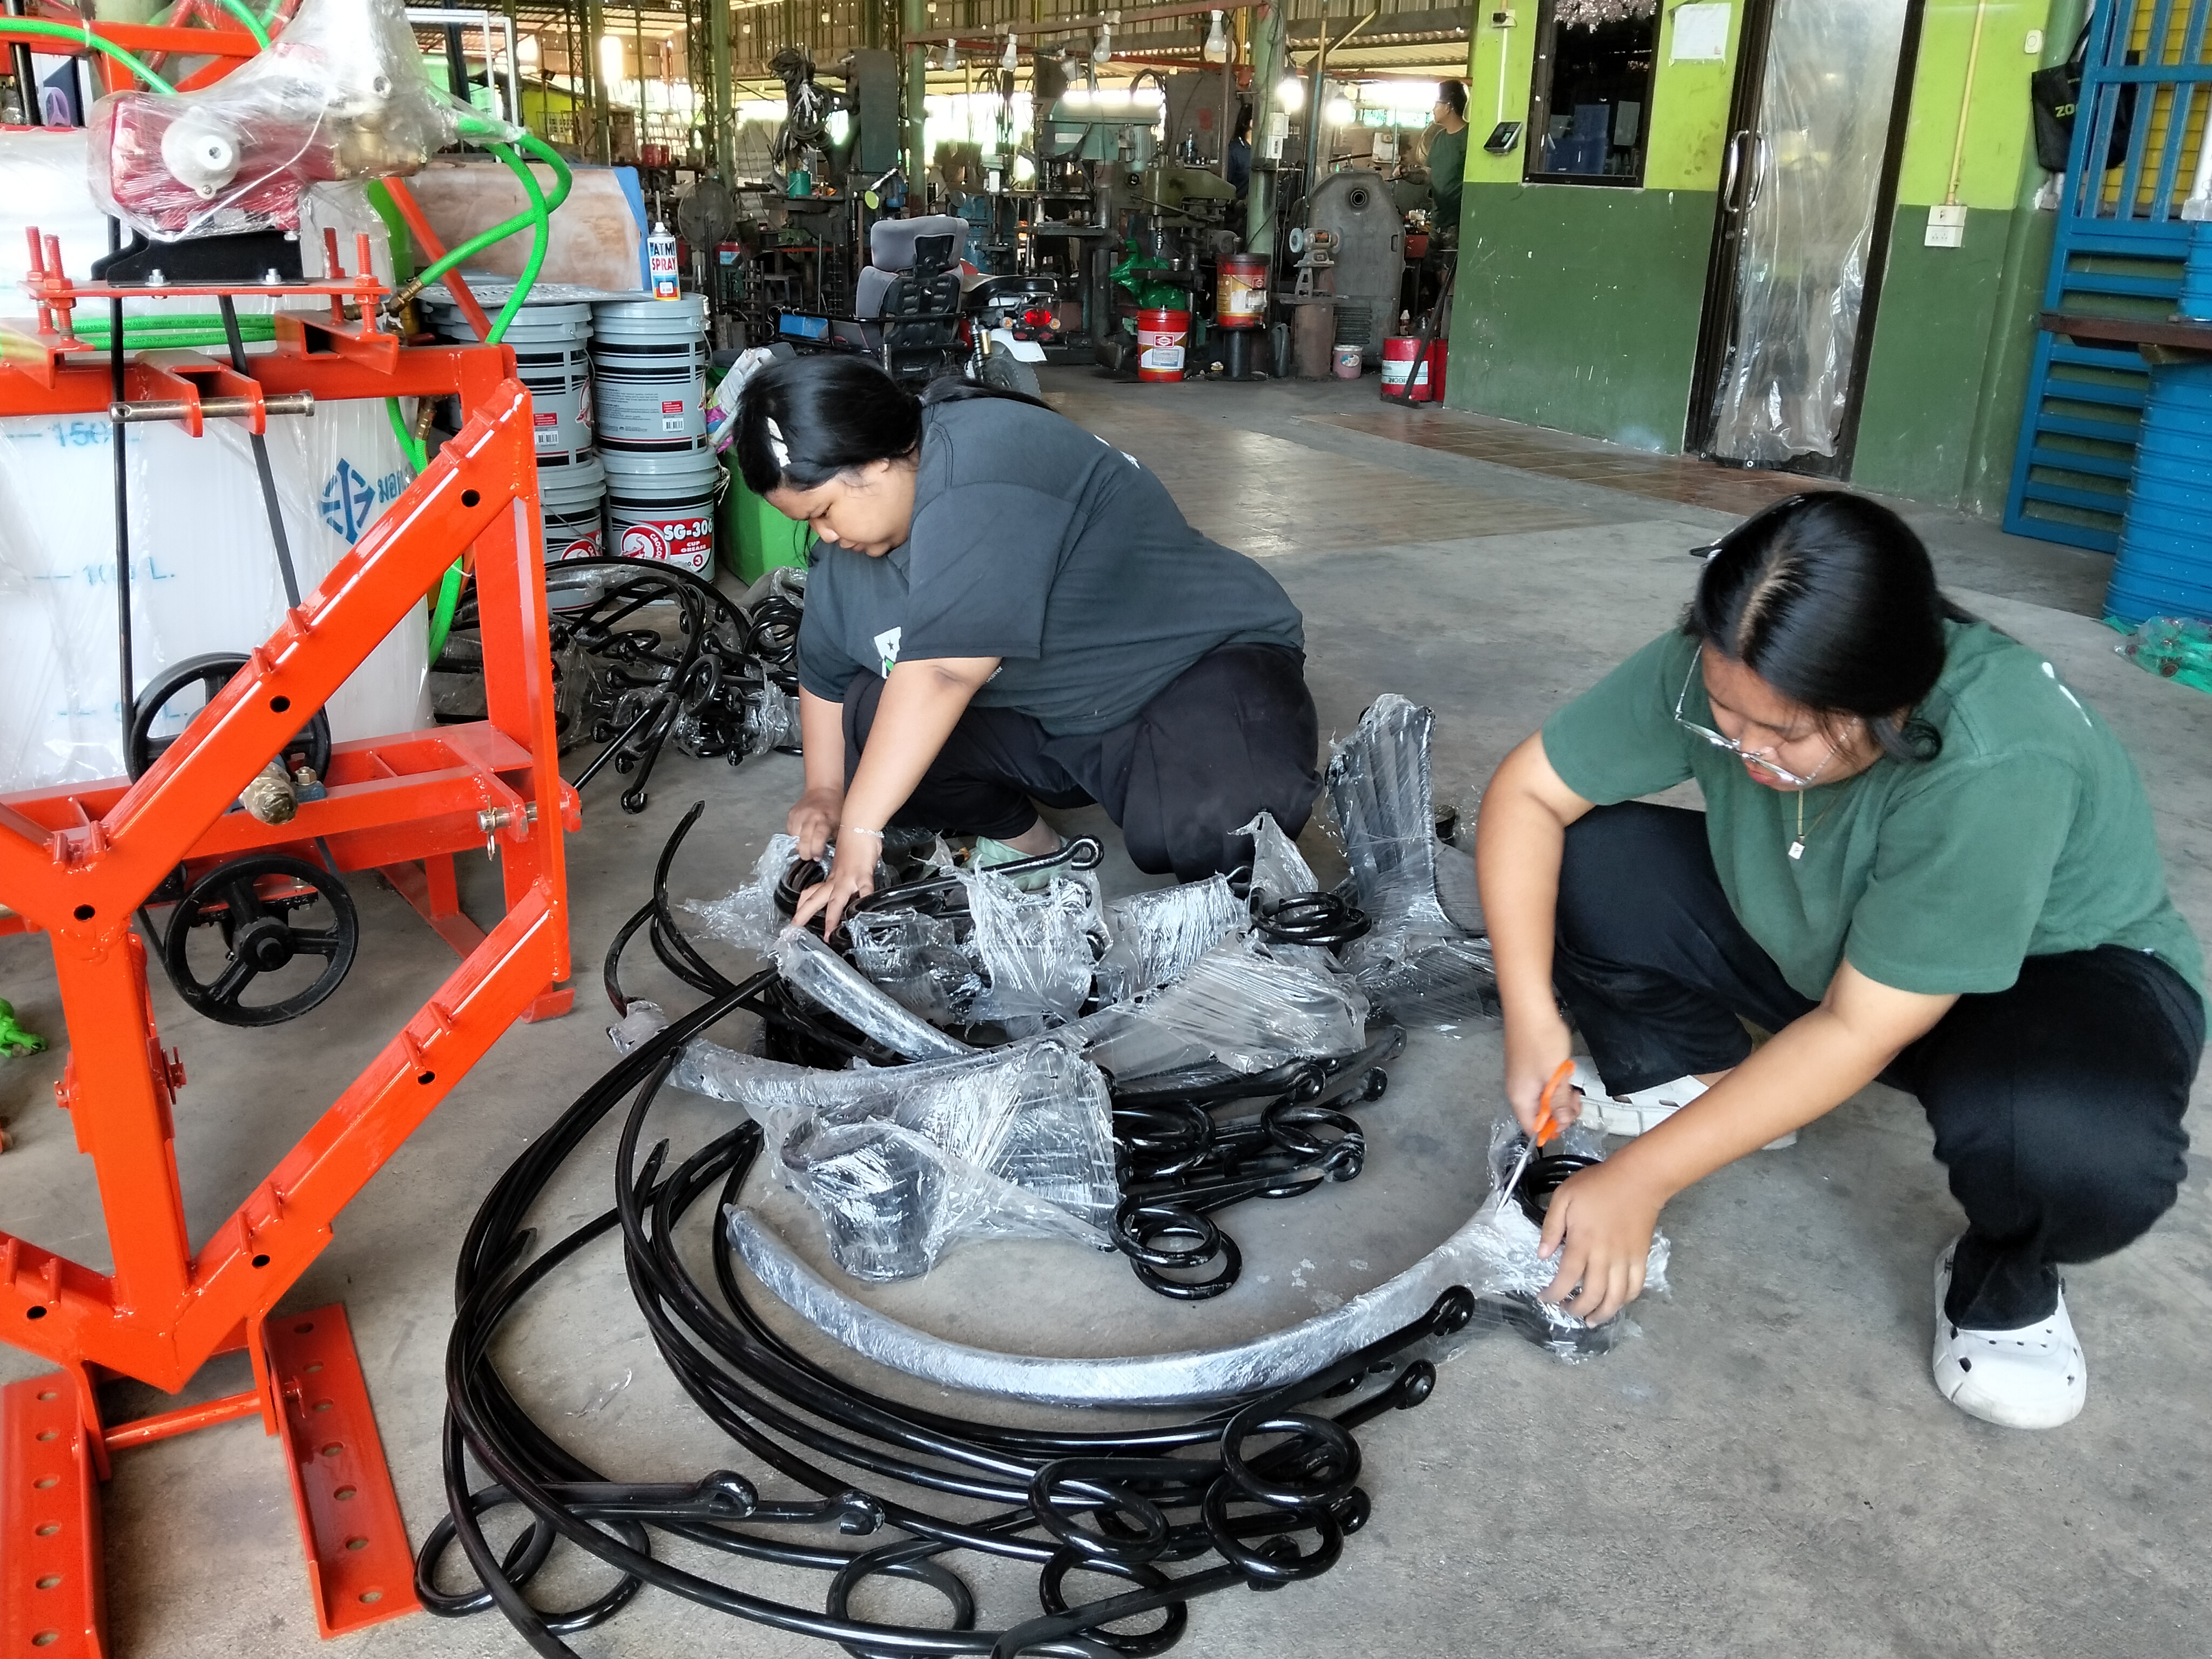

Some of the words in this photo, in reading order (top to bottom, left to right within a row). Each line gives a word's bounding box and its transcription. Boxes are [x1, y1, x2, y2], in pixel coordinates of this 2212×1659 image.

[2055, 104, 2076, 117] ZO
[654, 242, 673, 255] ATM
[652, 257, 676, 271] SPRAY
[664, 517, 713, 541] SG-306
[650, 533, 663, 559] CROCO
[680, 544, 706, 552] GREASE
[694, 556, 702, 565] 3
